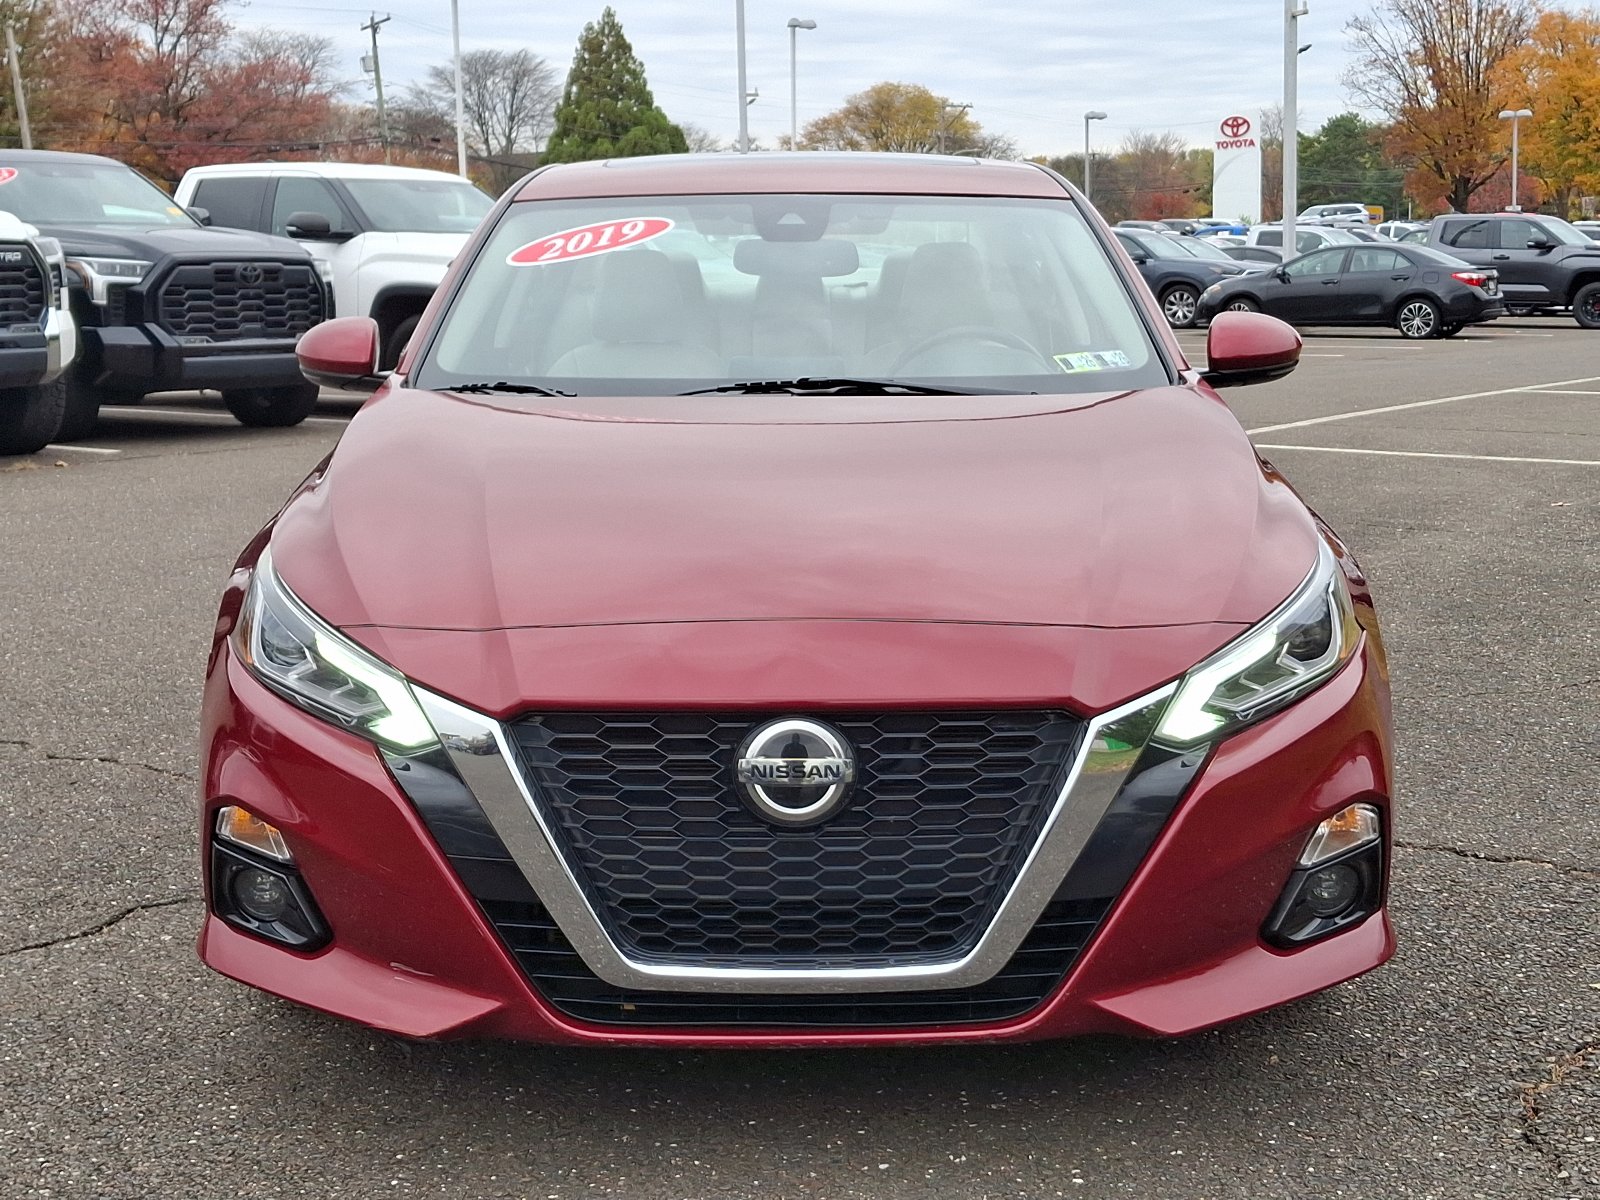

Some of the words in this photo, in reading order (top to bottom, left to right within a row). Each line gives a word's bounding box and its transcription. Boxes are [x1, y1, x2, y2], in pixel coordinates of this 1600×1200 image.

[1215, 138, 1256, 150] TOYOTA
[537, 219, 646, 261] 2019
[750, 764, 841, 779] NISSAN
